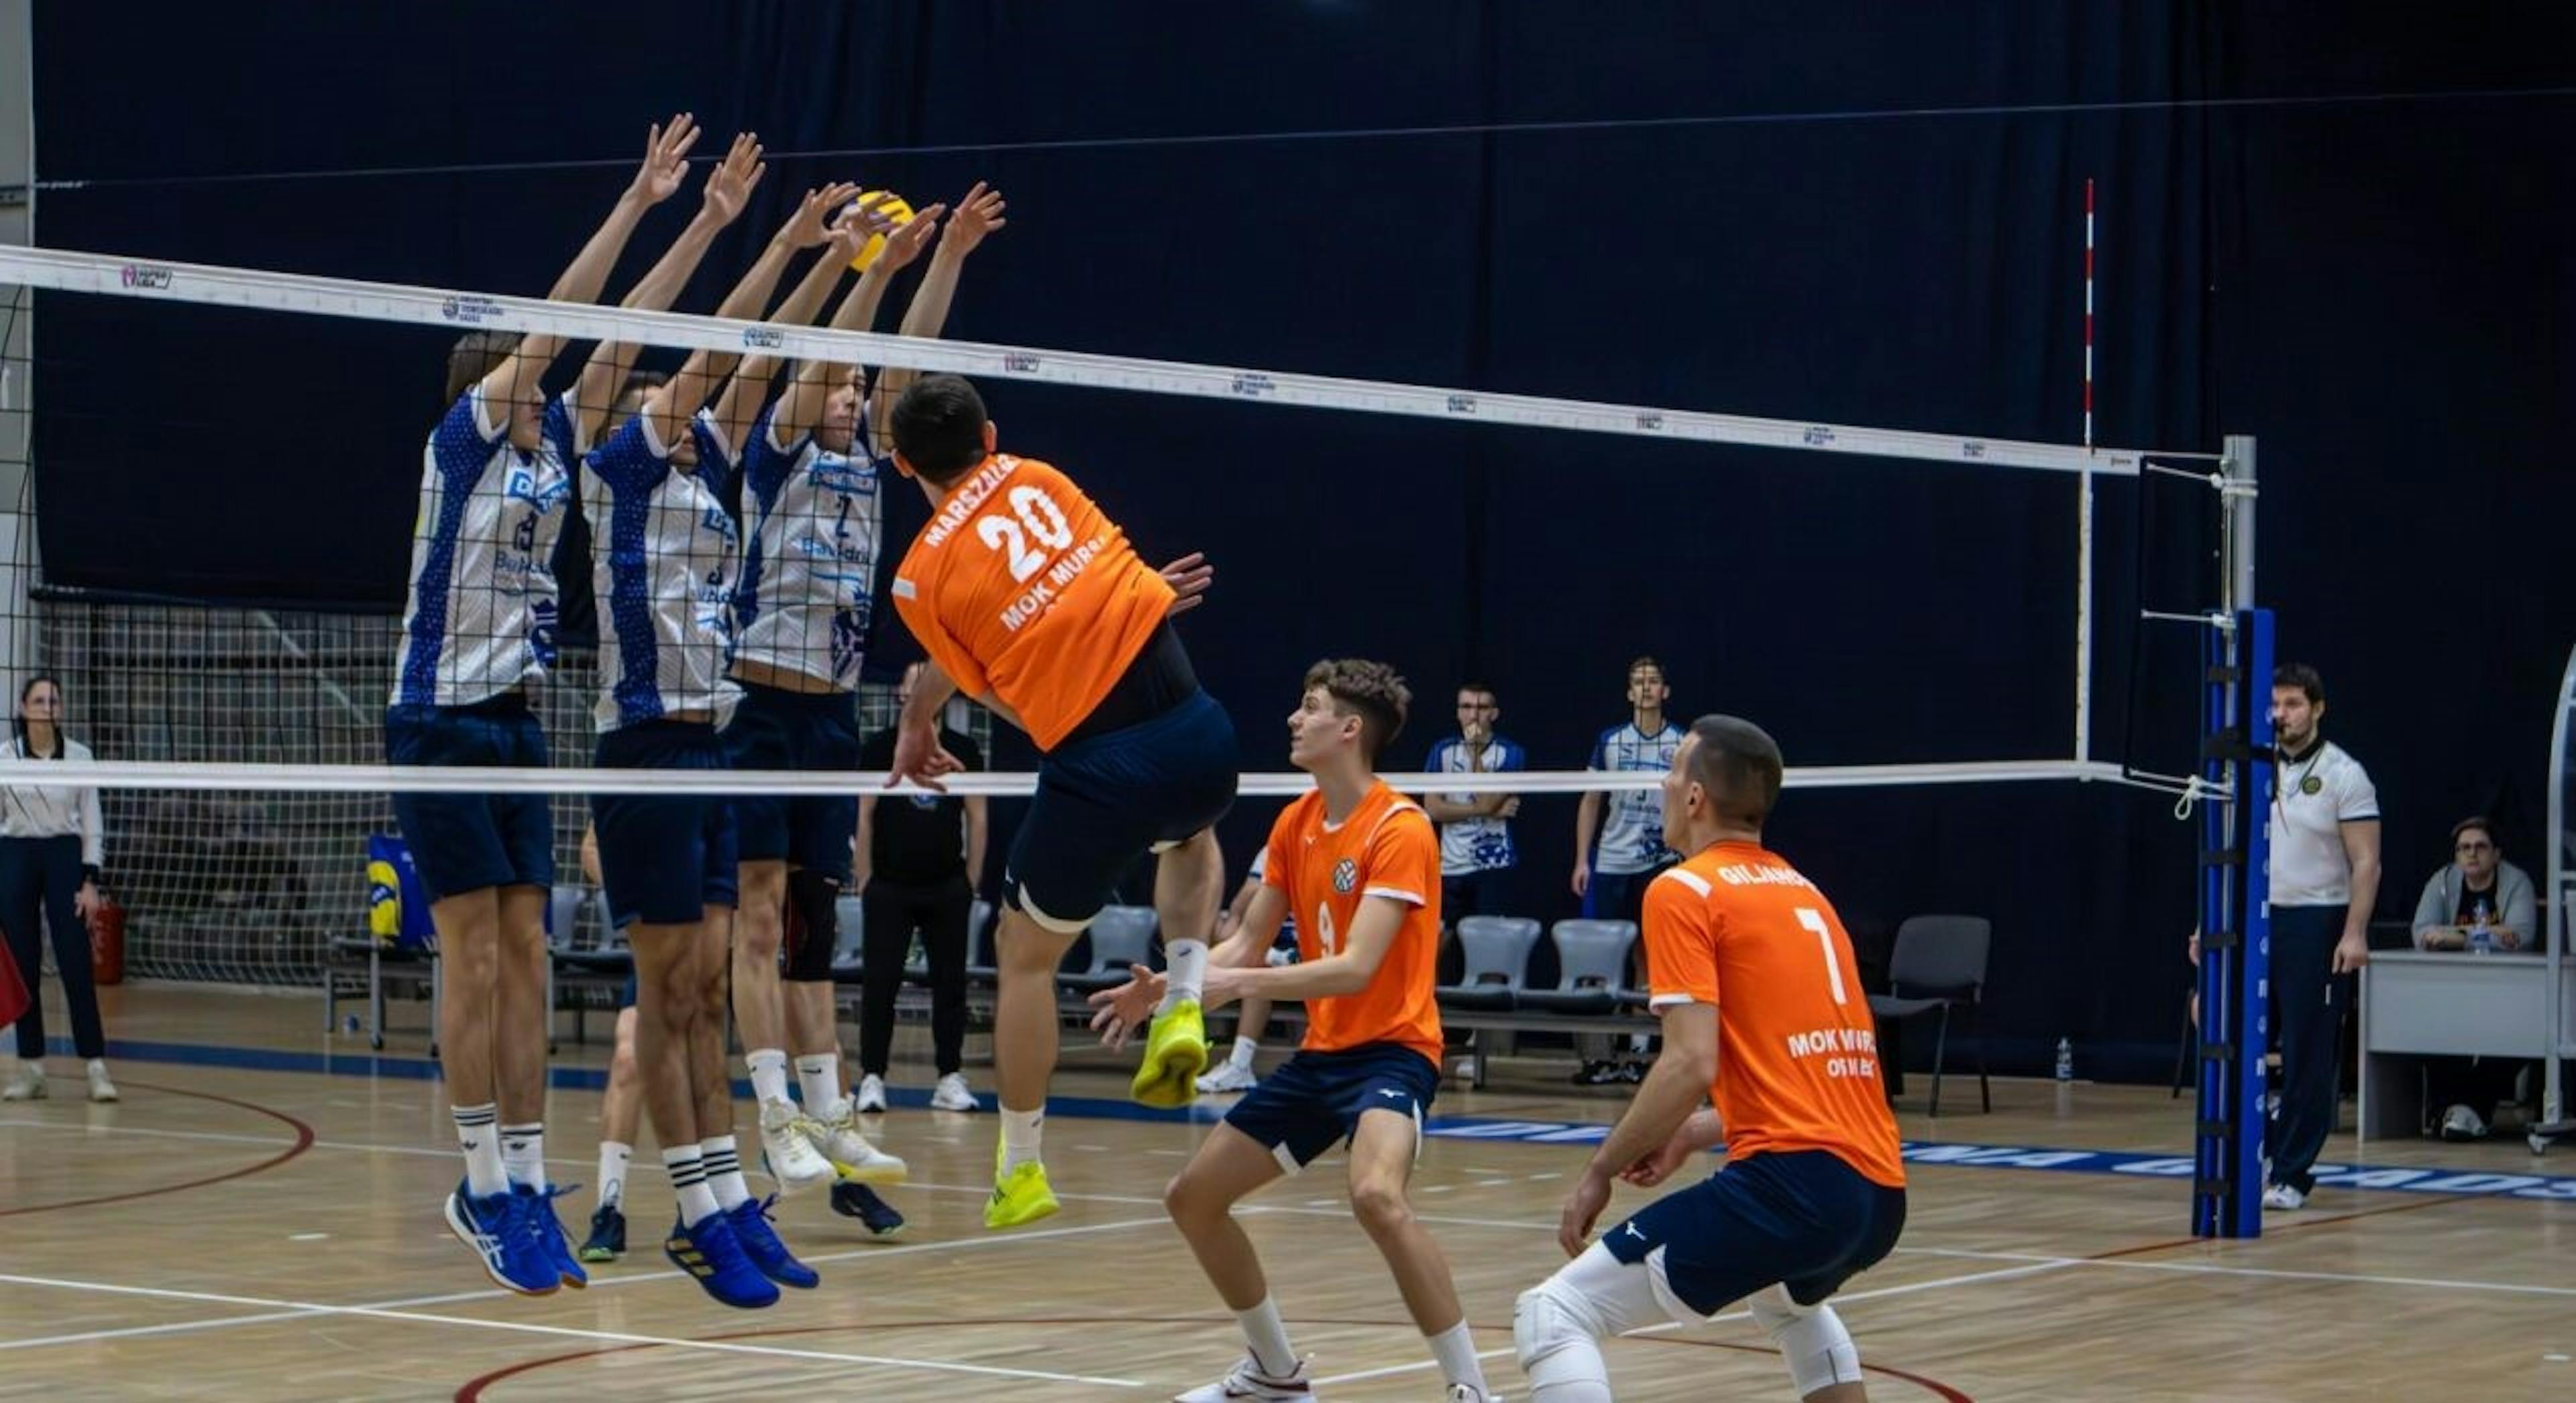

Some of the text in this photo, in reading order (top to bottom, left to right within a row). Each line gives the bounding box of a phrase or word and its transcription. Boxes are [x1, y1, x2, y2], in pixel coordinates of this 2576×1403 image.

[976, 484, 1073, 583] 20
[1000, 580, 1056, 632] MOK
[1793, 907, 1847, 1006] 7
[1787, 1029, 1839, 1058] MOK
